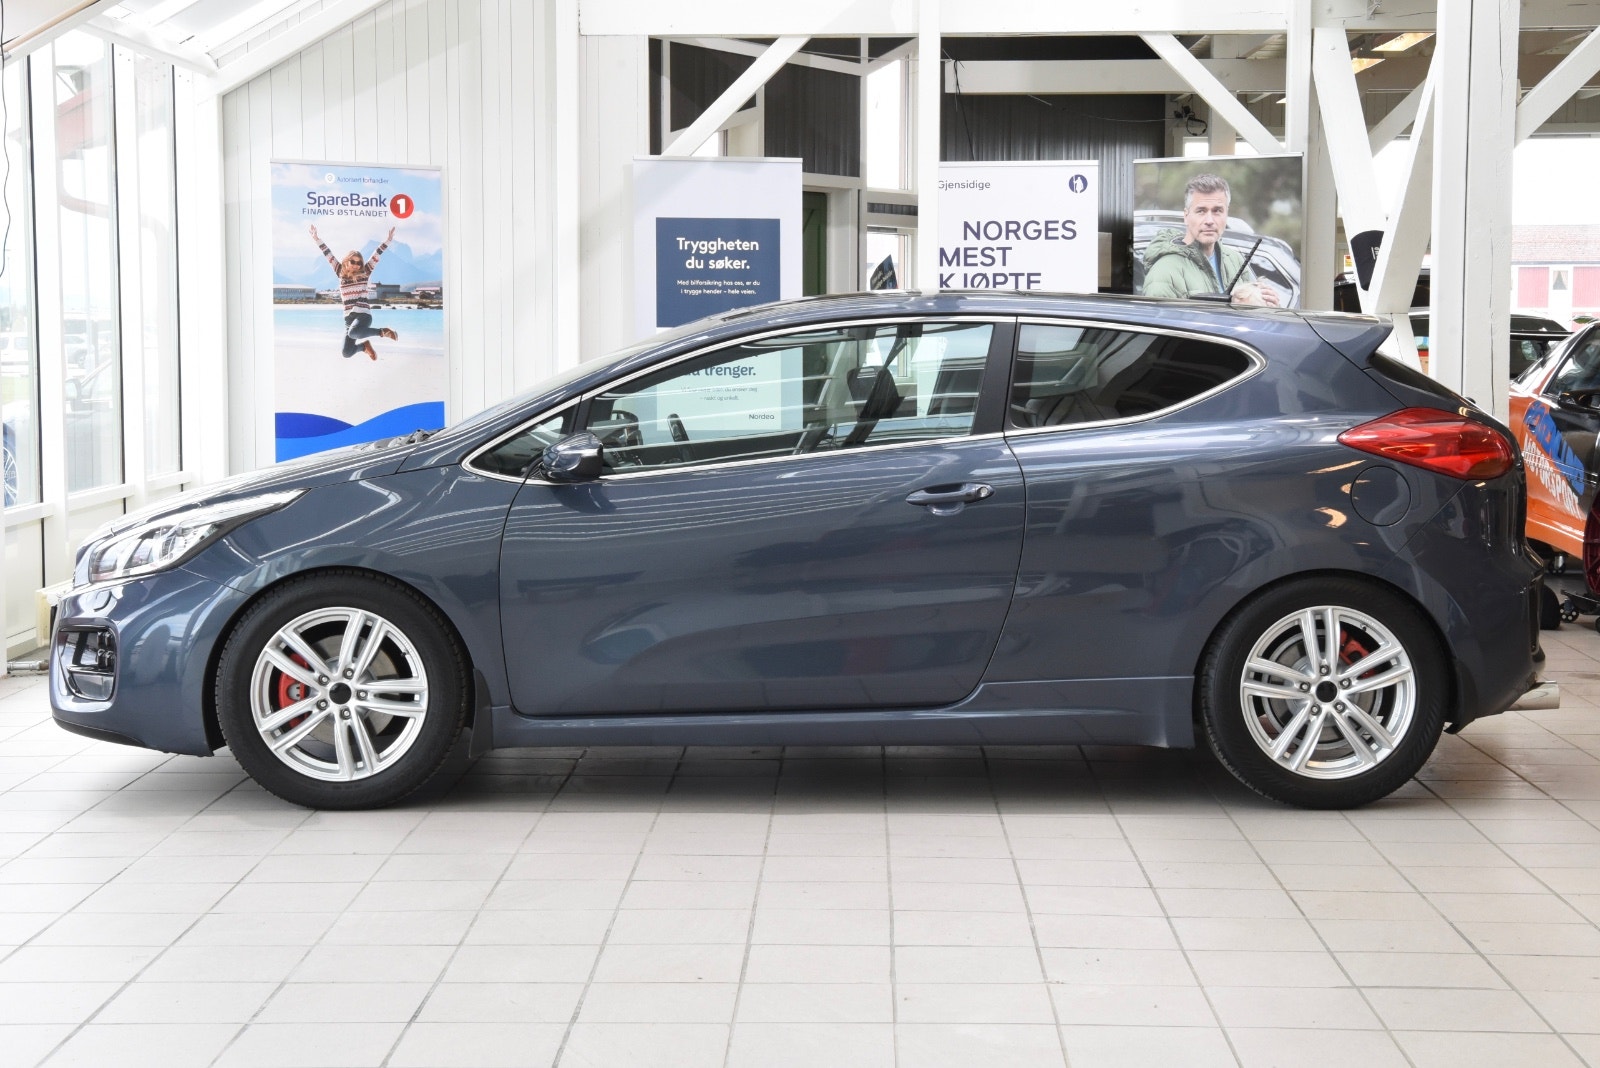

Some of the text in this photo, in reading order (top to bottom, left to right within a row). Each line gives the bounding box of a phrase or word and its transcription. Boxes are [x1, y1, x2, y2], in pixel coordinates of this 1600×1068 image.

[938, 180, 991, 191] Gjensidige
[307, 191, 387, 208] SpareBank
[302, 207, 388, 217] FINANS ØSTLANDET
[963, 219, 1077, 241] NORGES
[676, 237, 759, 254] Tryggheten
[685, 256, 750, 269] du søker.
[939, 246, 1013, 267] MEST
[704, 365, 757, 379] trenger.
